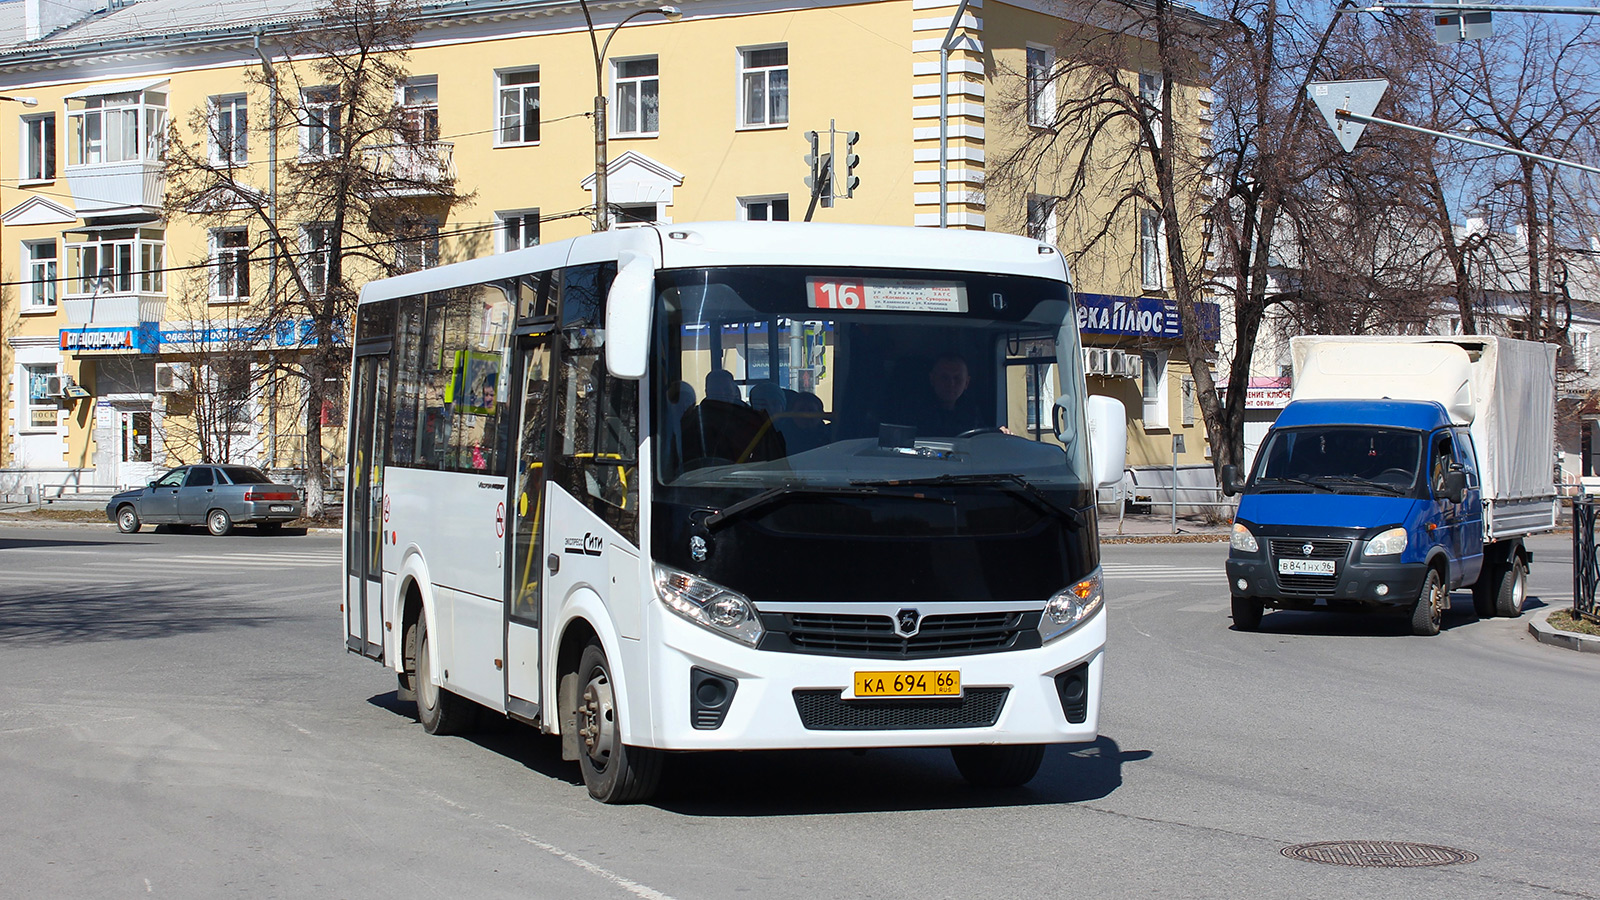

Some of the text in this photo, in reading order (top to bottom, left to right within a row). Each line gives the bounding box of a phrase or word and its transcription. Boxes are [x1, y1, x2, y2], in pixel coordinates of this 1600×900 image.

[820, 281, 860, 309] 16
[1248, 391, 1264, 399] ЕНИЕ
[1321, 561, 1332, 569] 96
[936, 672, 954, 687] 66
